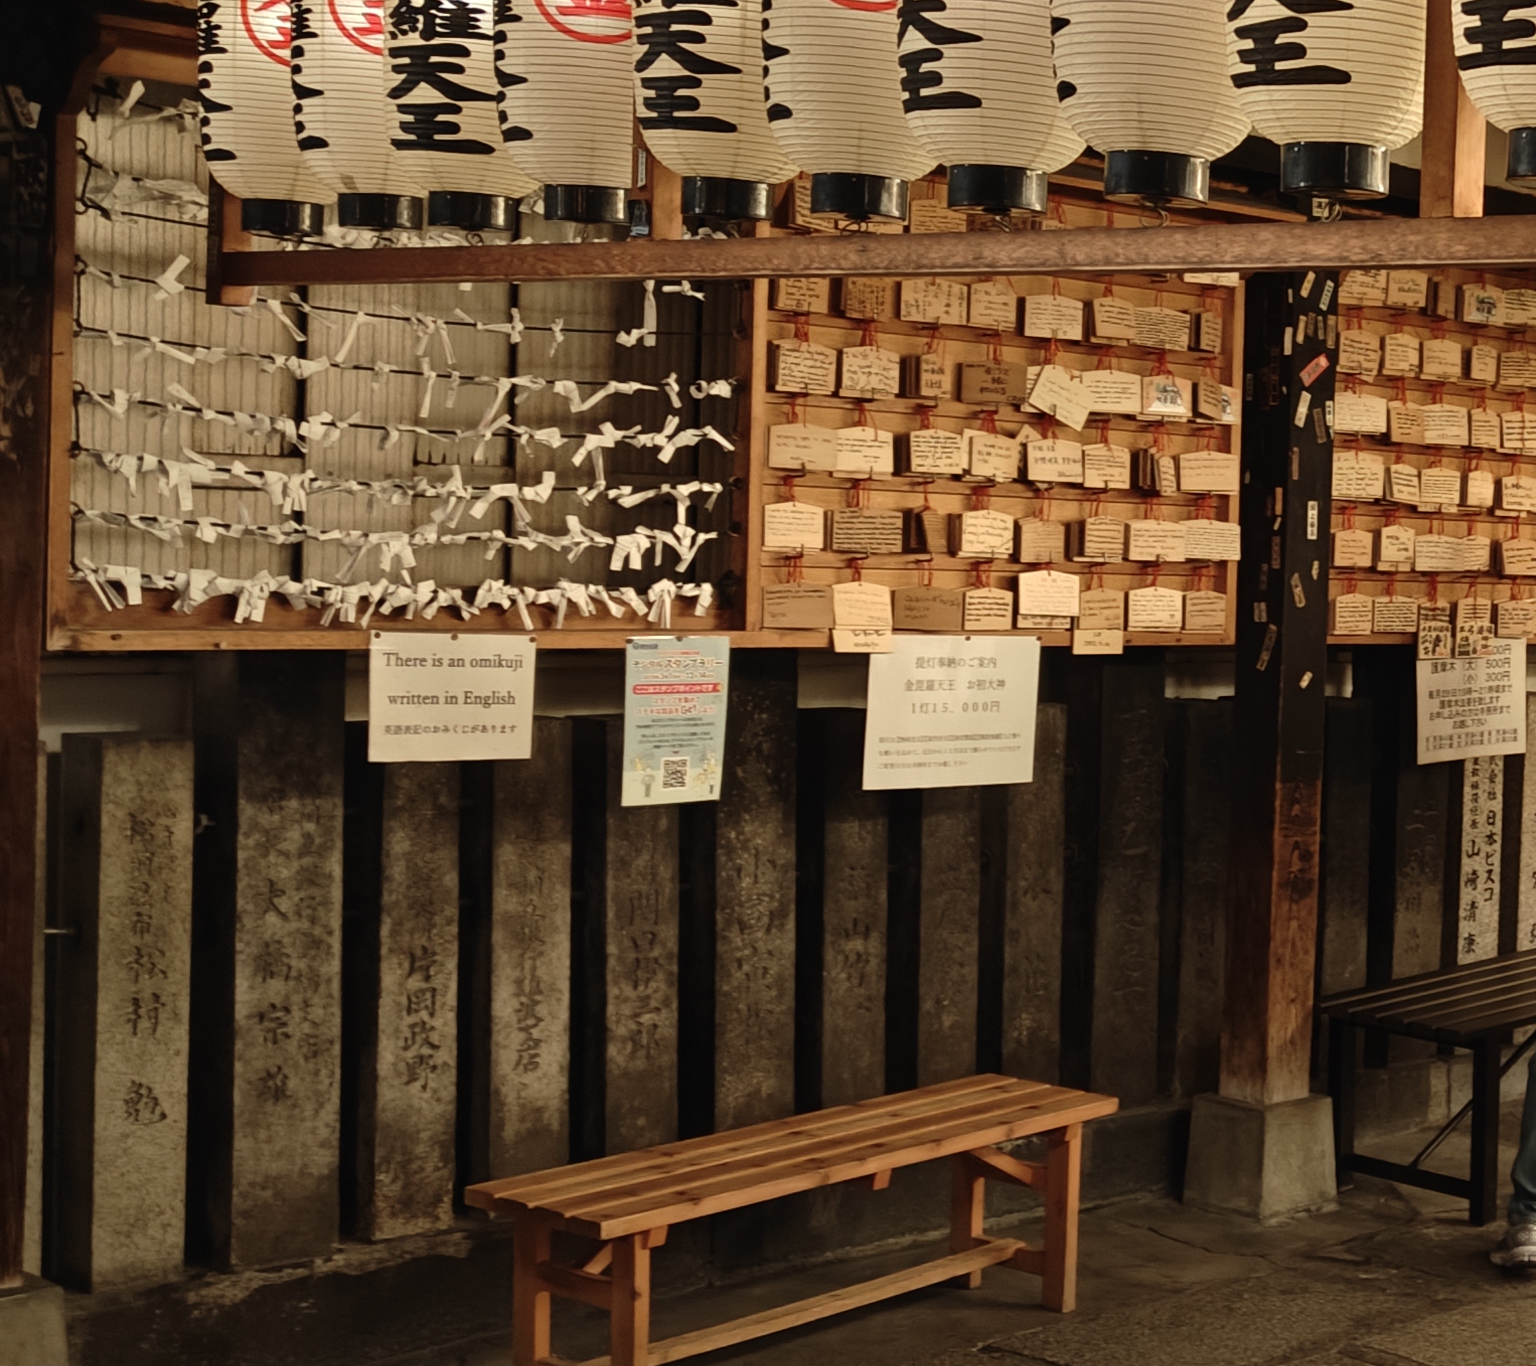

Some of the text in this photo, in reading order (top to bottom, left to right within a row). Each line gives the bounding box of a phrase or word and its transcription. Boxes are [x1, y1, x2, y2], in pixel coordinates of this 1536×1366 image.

[382, 652, 428, 668] There
[431, 653, 444, 668] is
[447, 657, 466, 668] an
[387, 690, 517, 709] written in English
